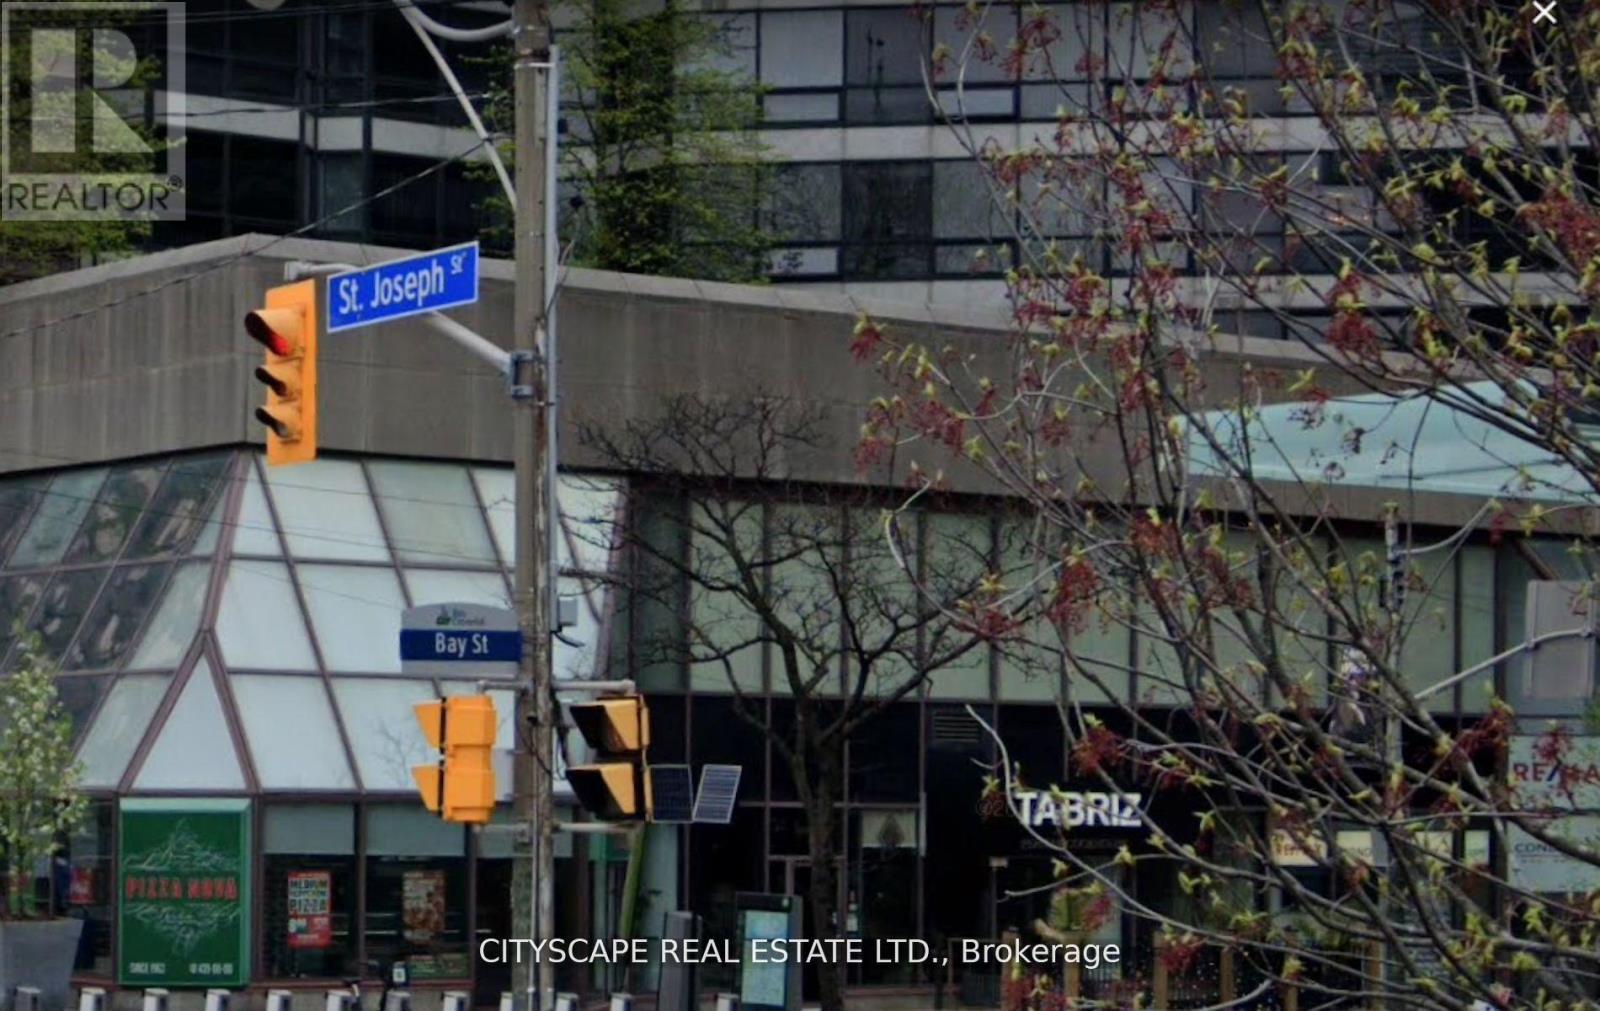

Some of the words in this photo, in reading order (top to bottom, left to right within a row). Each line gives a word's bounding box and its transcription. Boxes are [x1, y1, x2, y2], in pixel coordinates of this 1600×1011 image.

[339, 278, 364, 315] St.
[370, 258, 445, 308] Joseph
[435, 632, 468, 658] Bay
[472, 633, 489, 654] St
[1013, 792, 1142, 827] TABRIZ
[126, 877, 182, 899] PIZZA
[187, 876, 238, 899] NOVA
